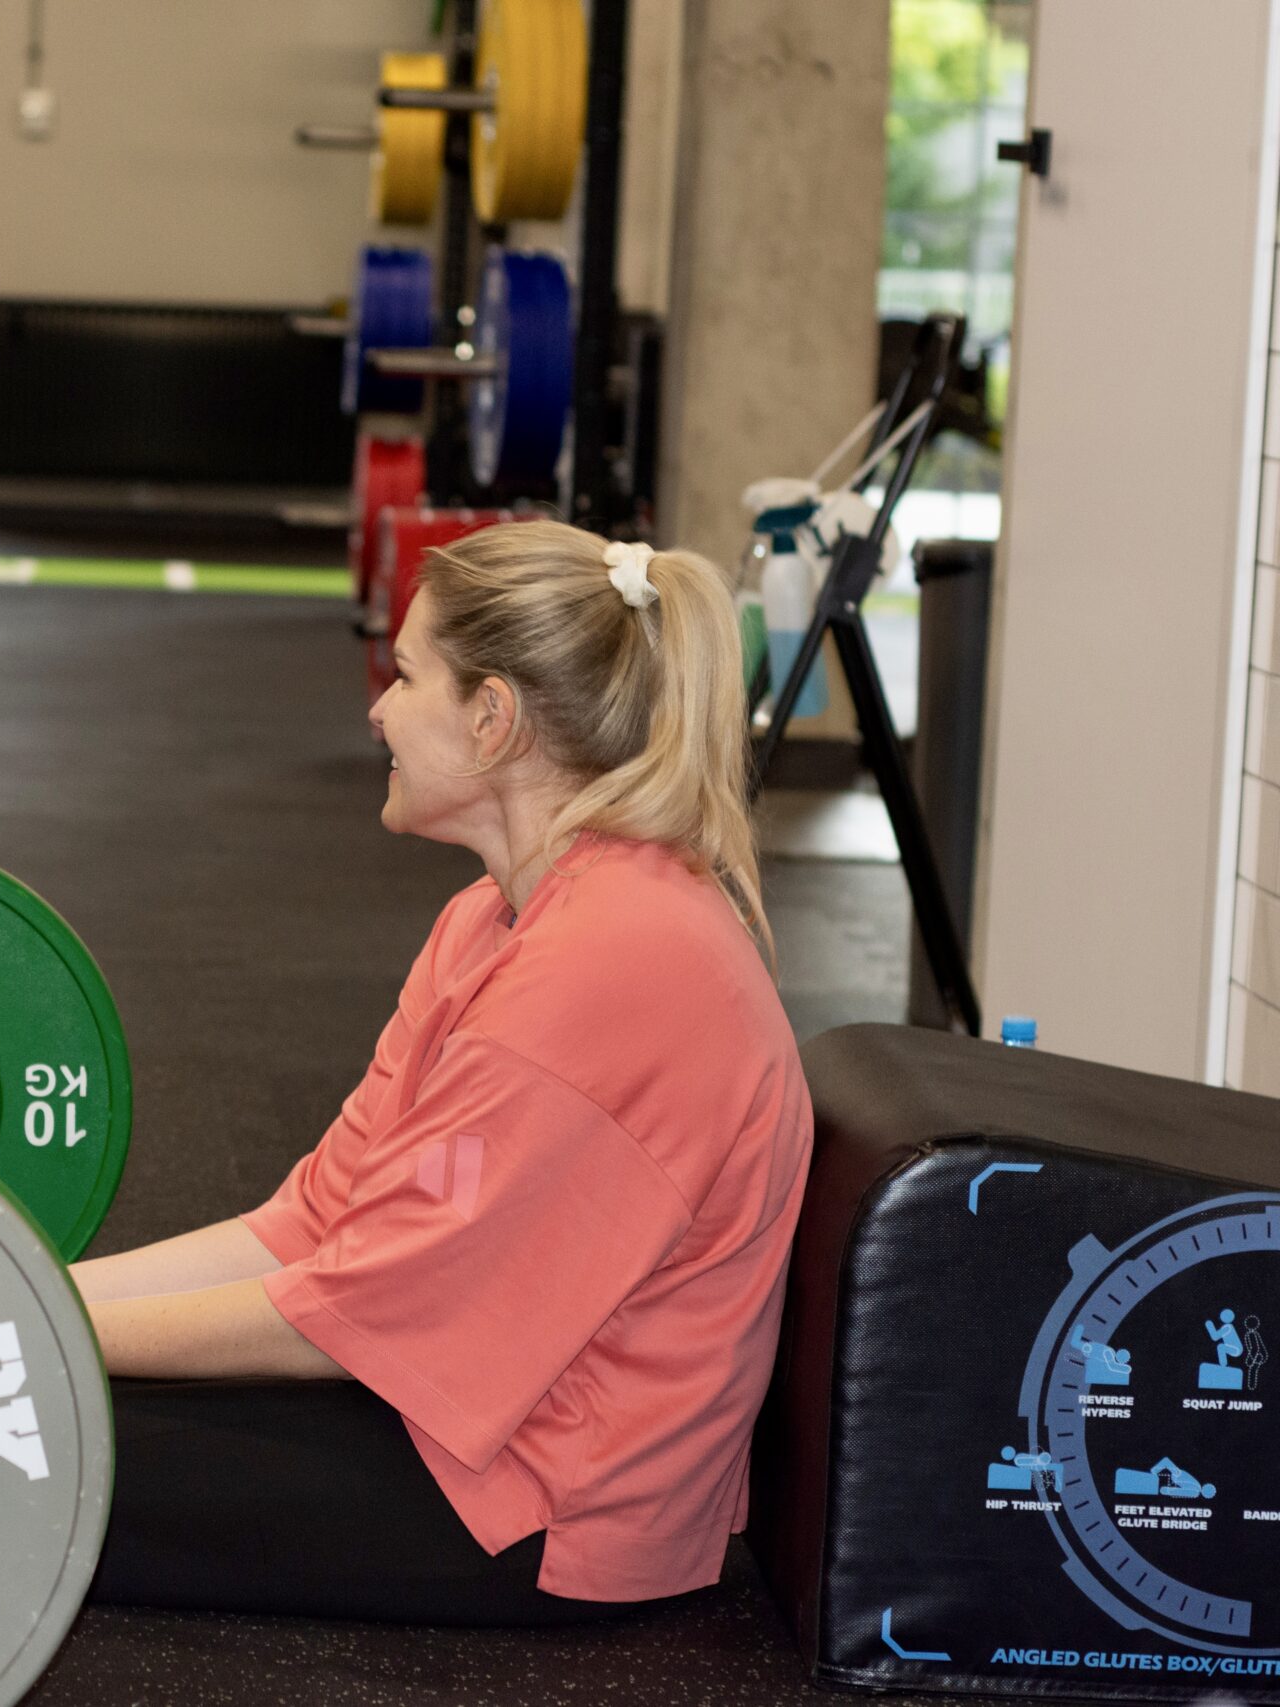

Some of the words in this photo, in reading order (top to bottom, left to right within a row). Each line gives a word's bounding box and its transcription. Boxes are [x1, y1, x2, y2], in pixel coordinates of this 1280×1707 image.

[24, 1063, 87, 1097] KG
[24, 1102, 87, 1147] 10
[1078, 1394, 1134, 1407] REVERSE
[1182, 1398, 1225, 1410] SQUAT
[1227, 1400, 1263, 1412] JUMP
[1081, 1407, 1132, 1419] HYPERS
[985, 1499, 1008, 1510] HIP
[1012, 1500, 1062, 1512] THRUST
[1114, 1504, 1145, 1516] FEET
[1148, 1505, 1213, 1519] ELEVATED
[1243, 1509, 1280, 1522] BAND
[1117, 1517, 1158, 1529] GLUTE
[1161, 1518, 1208, 1531] BRIDGE
[990, 1648, 1080, 1667] ANGLED
[1083, 1651, 1163, 1671] GLUTES
